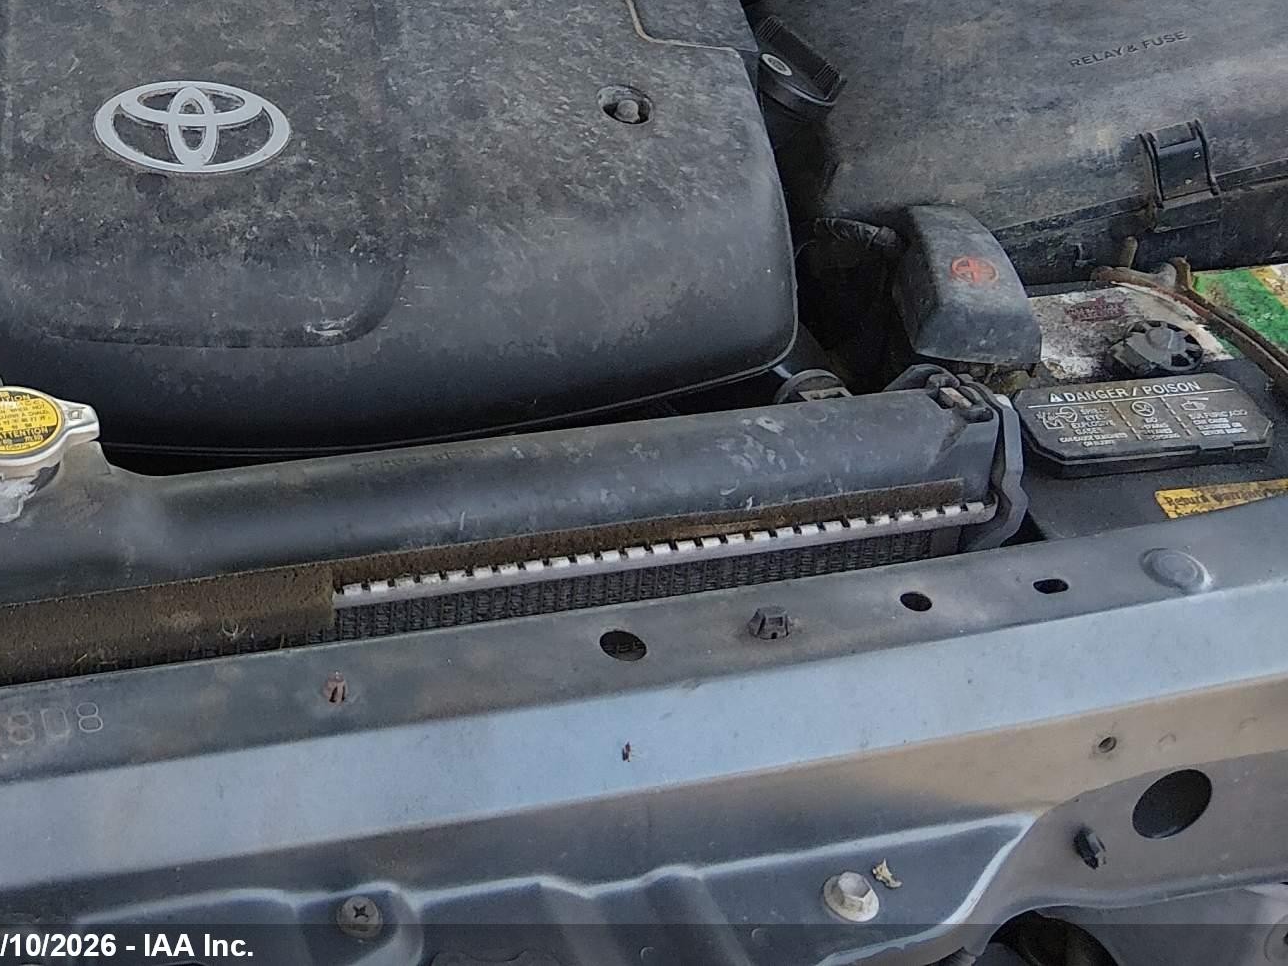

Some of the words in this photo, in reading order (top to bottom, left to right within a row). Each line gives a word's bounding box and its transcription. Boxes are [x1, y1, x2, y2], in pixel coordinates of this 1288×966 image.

[1070, 46, 1123, 67] RELAY
[1142, 30, 1188, 50] FUSE
[1062, 387, 1128, 403] DANGER
[1142, 381, 1201, 396] POISON
